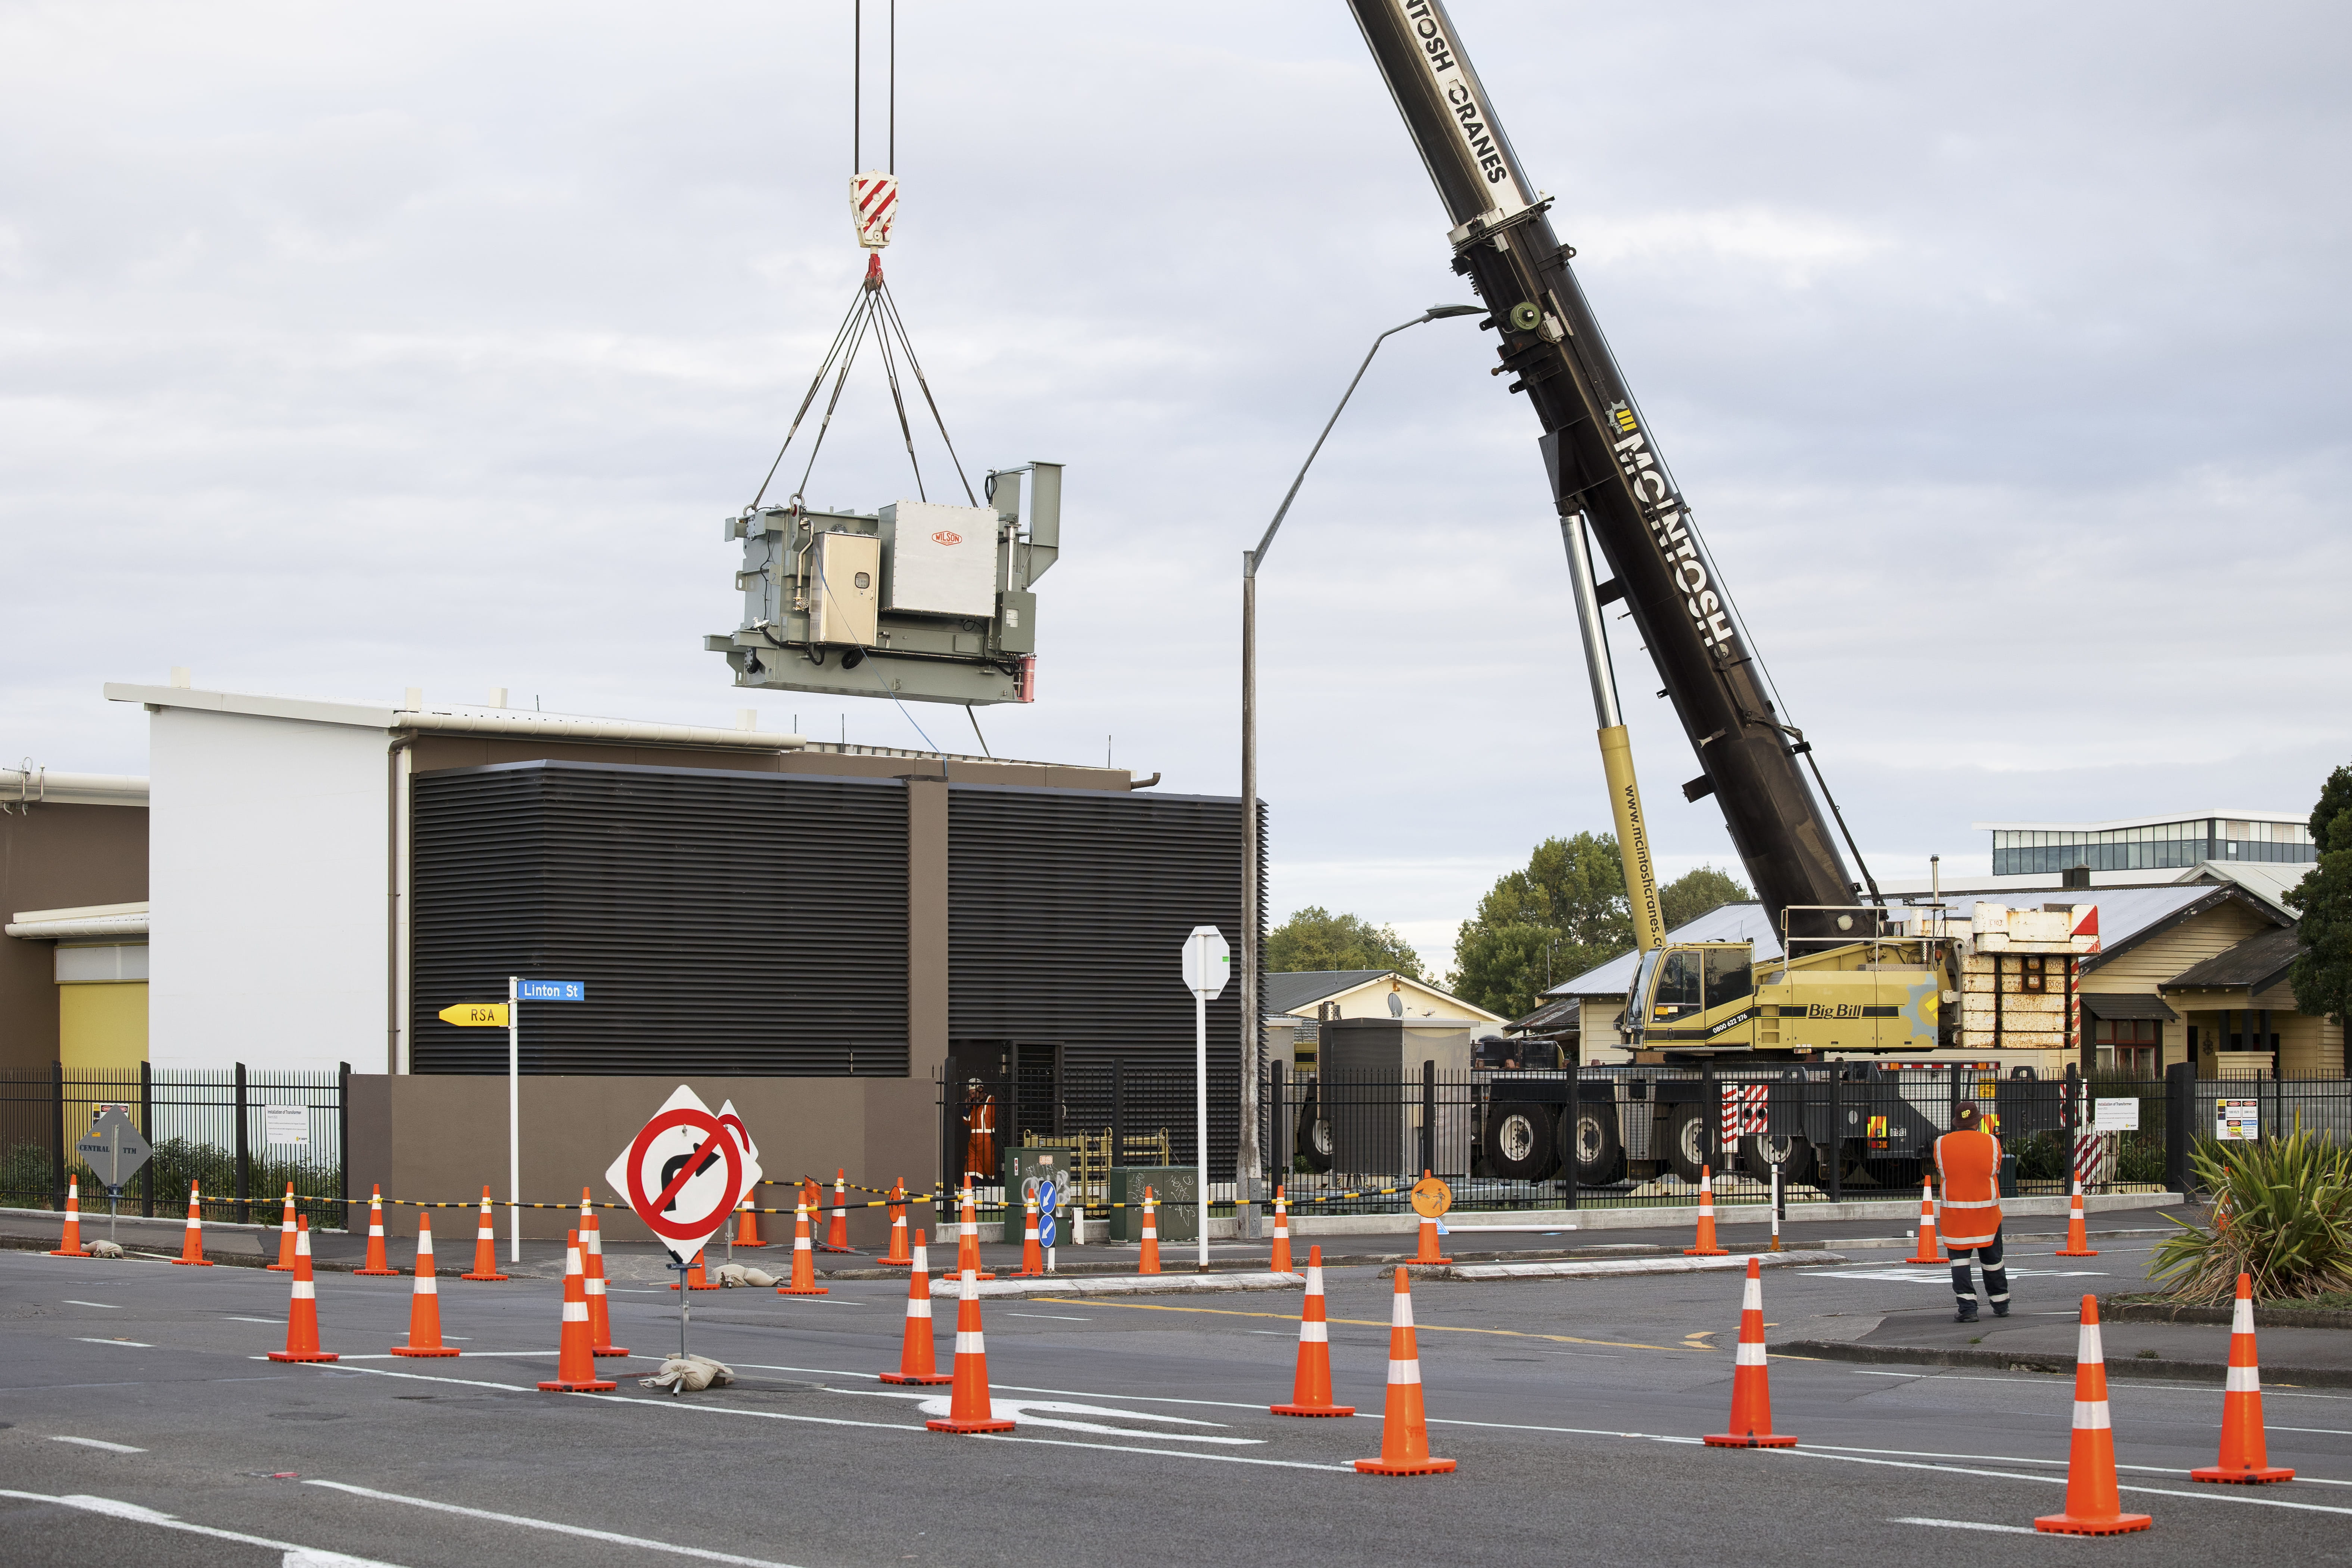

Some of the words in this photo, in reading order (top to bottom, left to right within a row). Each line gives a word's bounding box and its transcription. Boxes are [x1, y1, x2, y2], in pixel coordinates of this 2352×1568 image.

[1449, 84, 1507, 183] CRANES
[936, 532, 959, 542] WILSON
[1614, 432, 1733, 647] MCINTOSH
[524, 984, 560, 997] Linton
[566, 984, 578, 998] St
[471, 1009, 495, 1021] RSA
[1809, 1004, 1834, 1019] Big
[1836, 1004, 1861, 1016] Bill
[1713, 1023, 1727, 1033] 0800
[1727, 1018, 1737, 1027] 622
[1737, 1013, 1747, 1022] 276
[1961, 1110, 1970, 1118] L&P
[80, 1144, 110, 1152] CENTRAL
